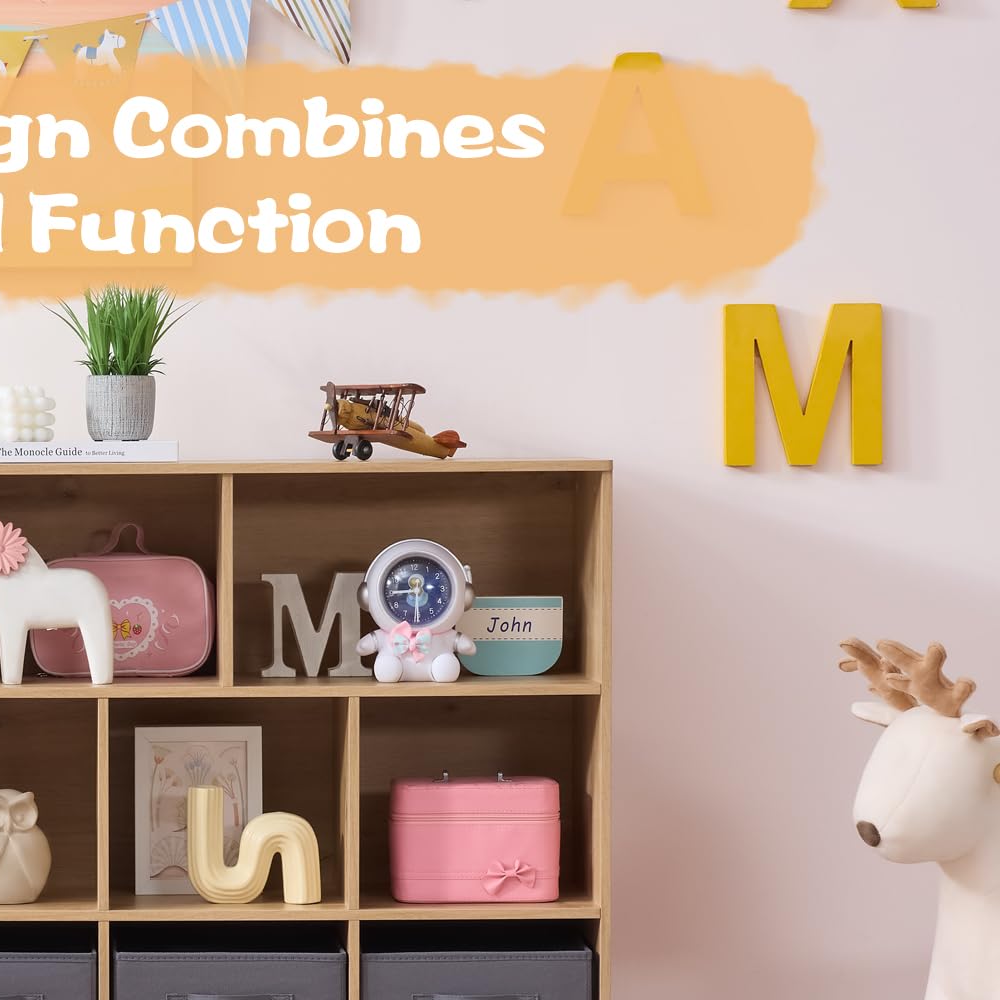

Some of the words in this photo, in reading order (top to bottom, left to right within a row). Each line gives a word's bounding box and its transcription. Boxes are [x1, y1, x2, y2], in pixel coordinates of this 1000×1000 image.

[723, 303, 884, 468] M
[14, 447, 54, 457] Monocle
[55, 447, 83, 457] Guide
[261, 572, 373, 677] M
[487, 616, 532, 633] John
